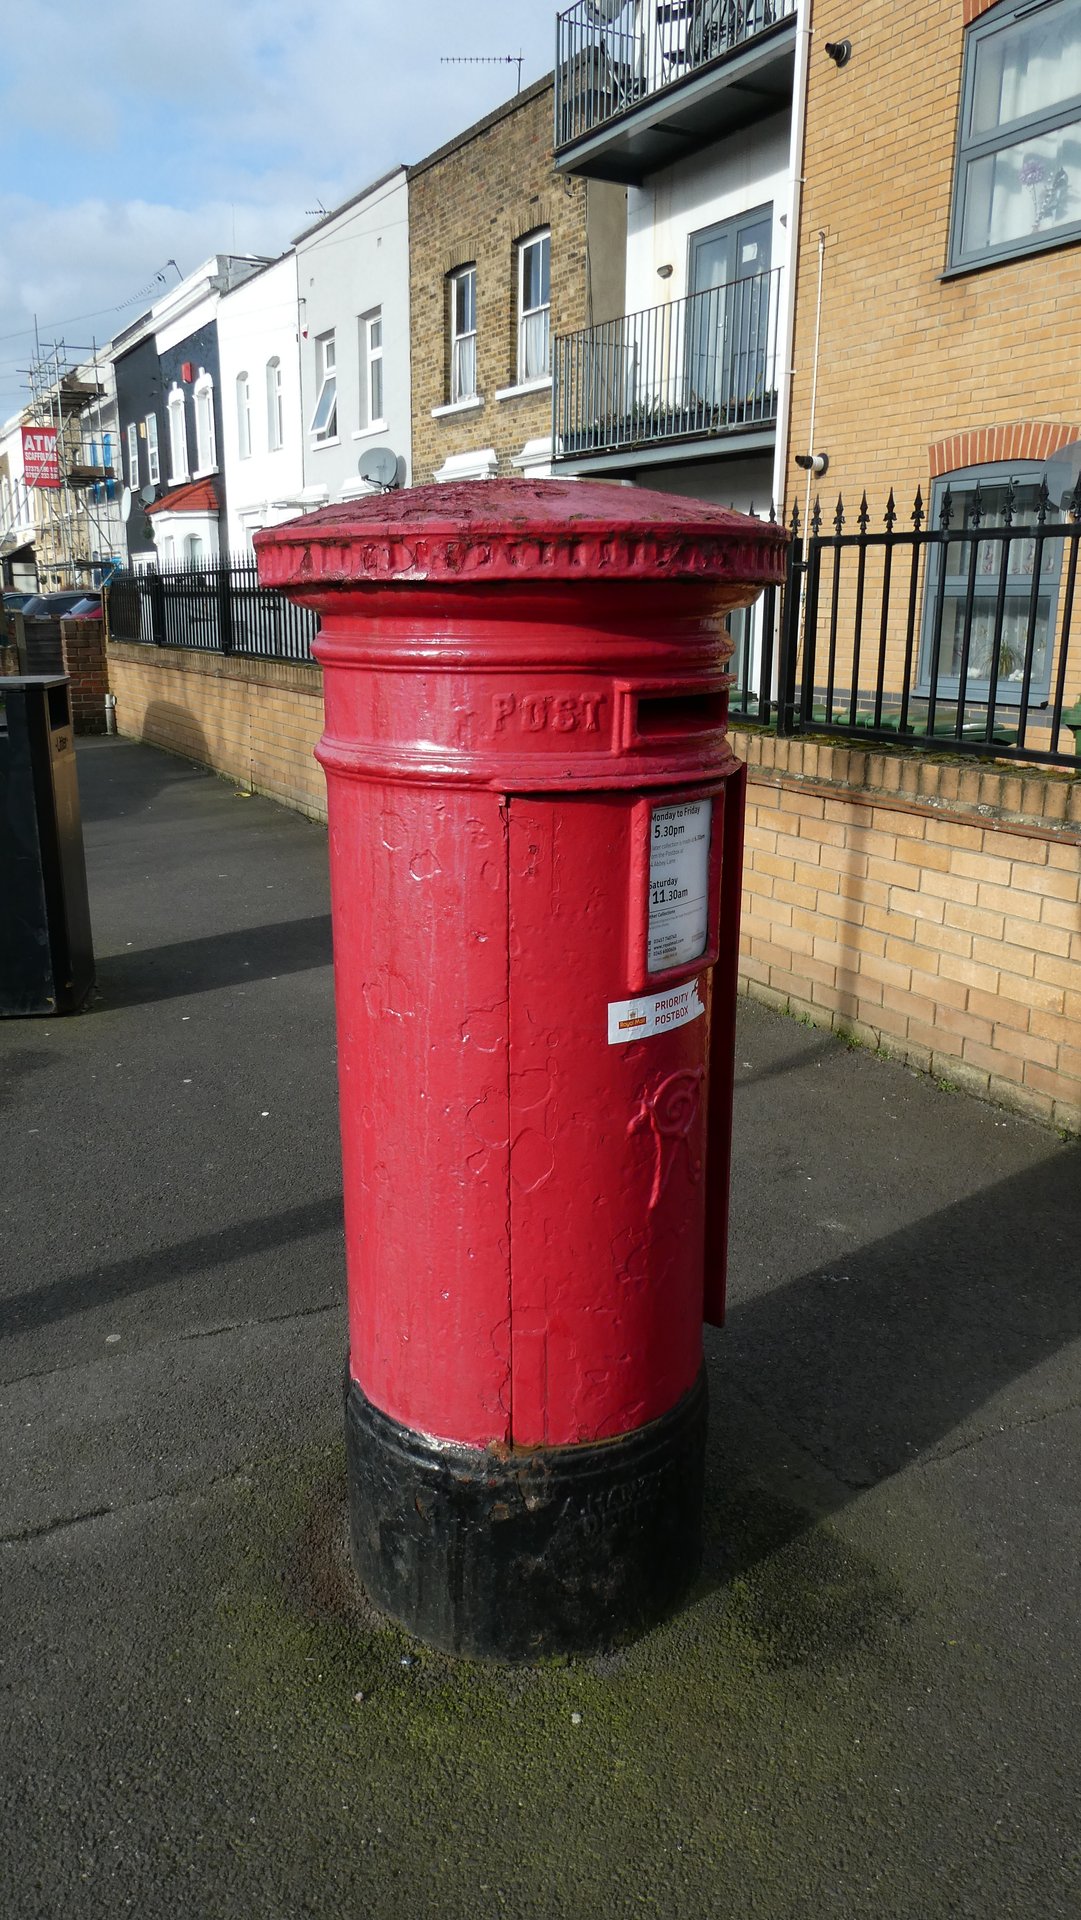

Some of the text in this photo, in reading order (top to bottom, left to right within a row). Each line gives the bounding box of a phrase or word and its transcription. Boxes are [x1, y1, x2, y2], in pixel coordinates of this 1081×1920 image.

[24, 435, 57, 452] ATM
[492, 691, 608, 733] POST
[652, 805, 700, 822] Monday to Friday
[654, 824, 685, 839] 5.30pm
[649, 877, 679, 890] Saturday
[652, 888, 688, 905] 11.30am
[655, 991, 689, 1012] PRIORITY
[655, 1006, 689, 1026] POSTBOX
